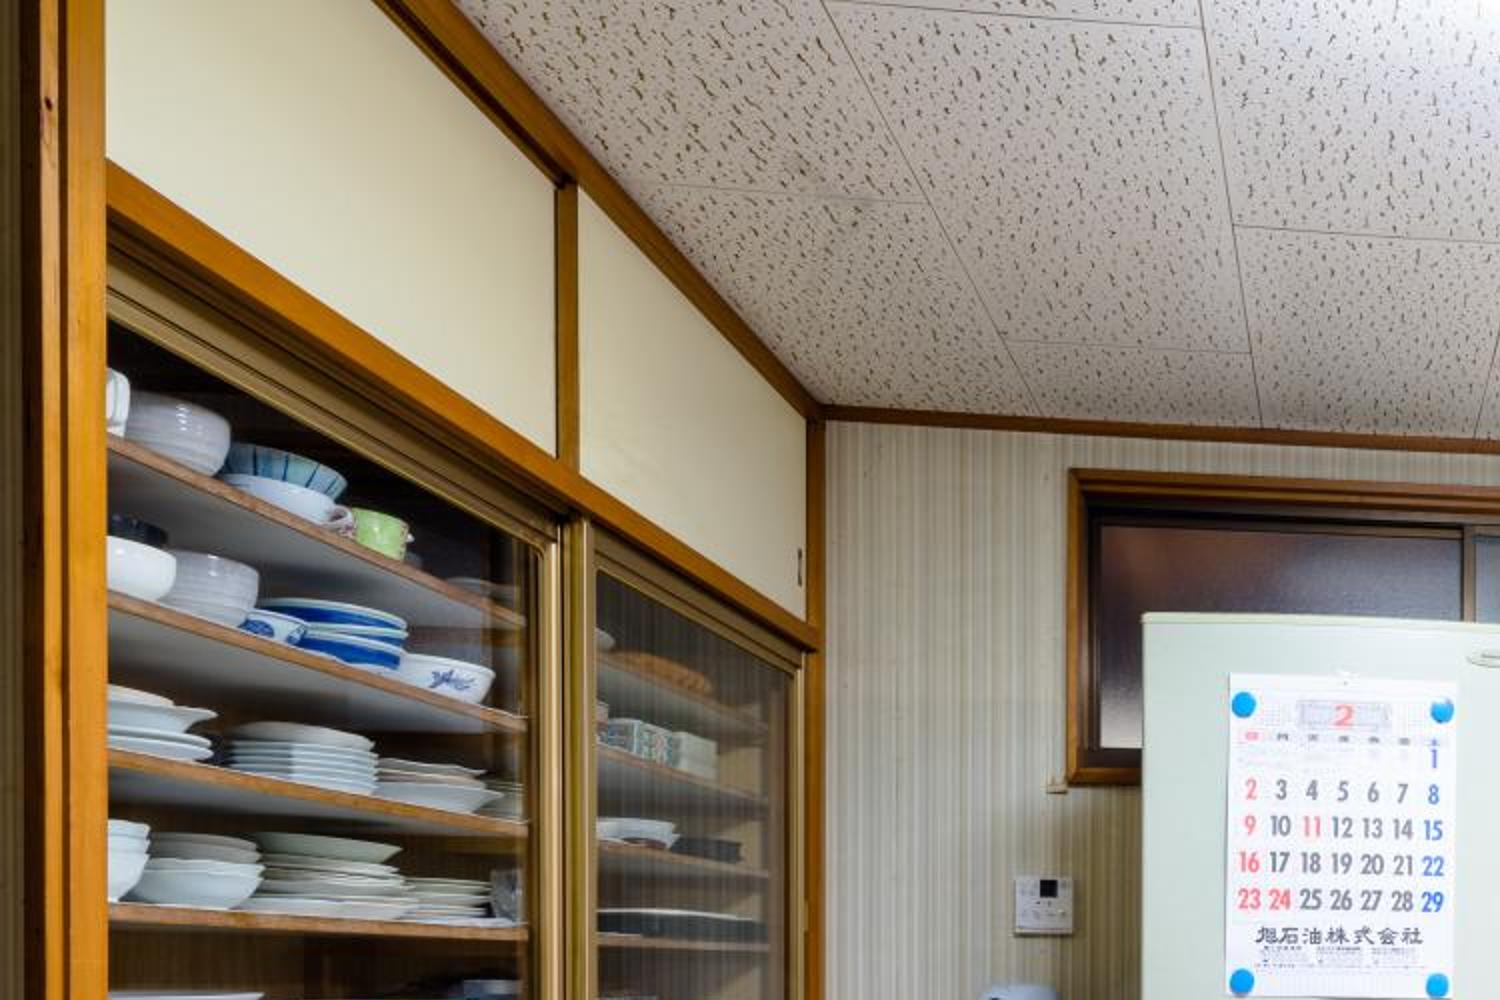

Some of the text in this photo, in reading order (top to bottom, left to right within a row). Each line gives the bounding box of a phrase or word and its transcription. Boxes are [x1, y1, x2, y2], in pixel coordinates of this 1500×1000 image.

[1333, 704, 1354, 727] 2
[1245, 778, 1441, 806] 2 3 4 5 6 7 8
[1244, 814, 1443, 841] 9 10 11 12 13 14 15
[1239, 851, 1445, 878] 16 17 18 19 20 21 22
[1237, 887, 1445, 913] 23 24 25 26 27 28 29
[1255, 926, 1423, 945] 旭石油株式会社
